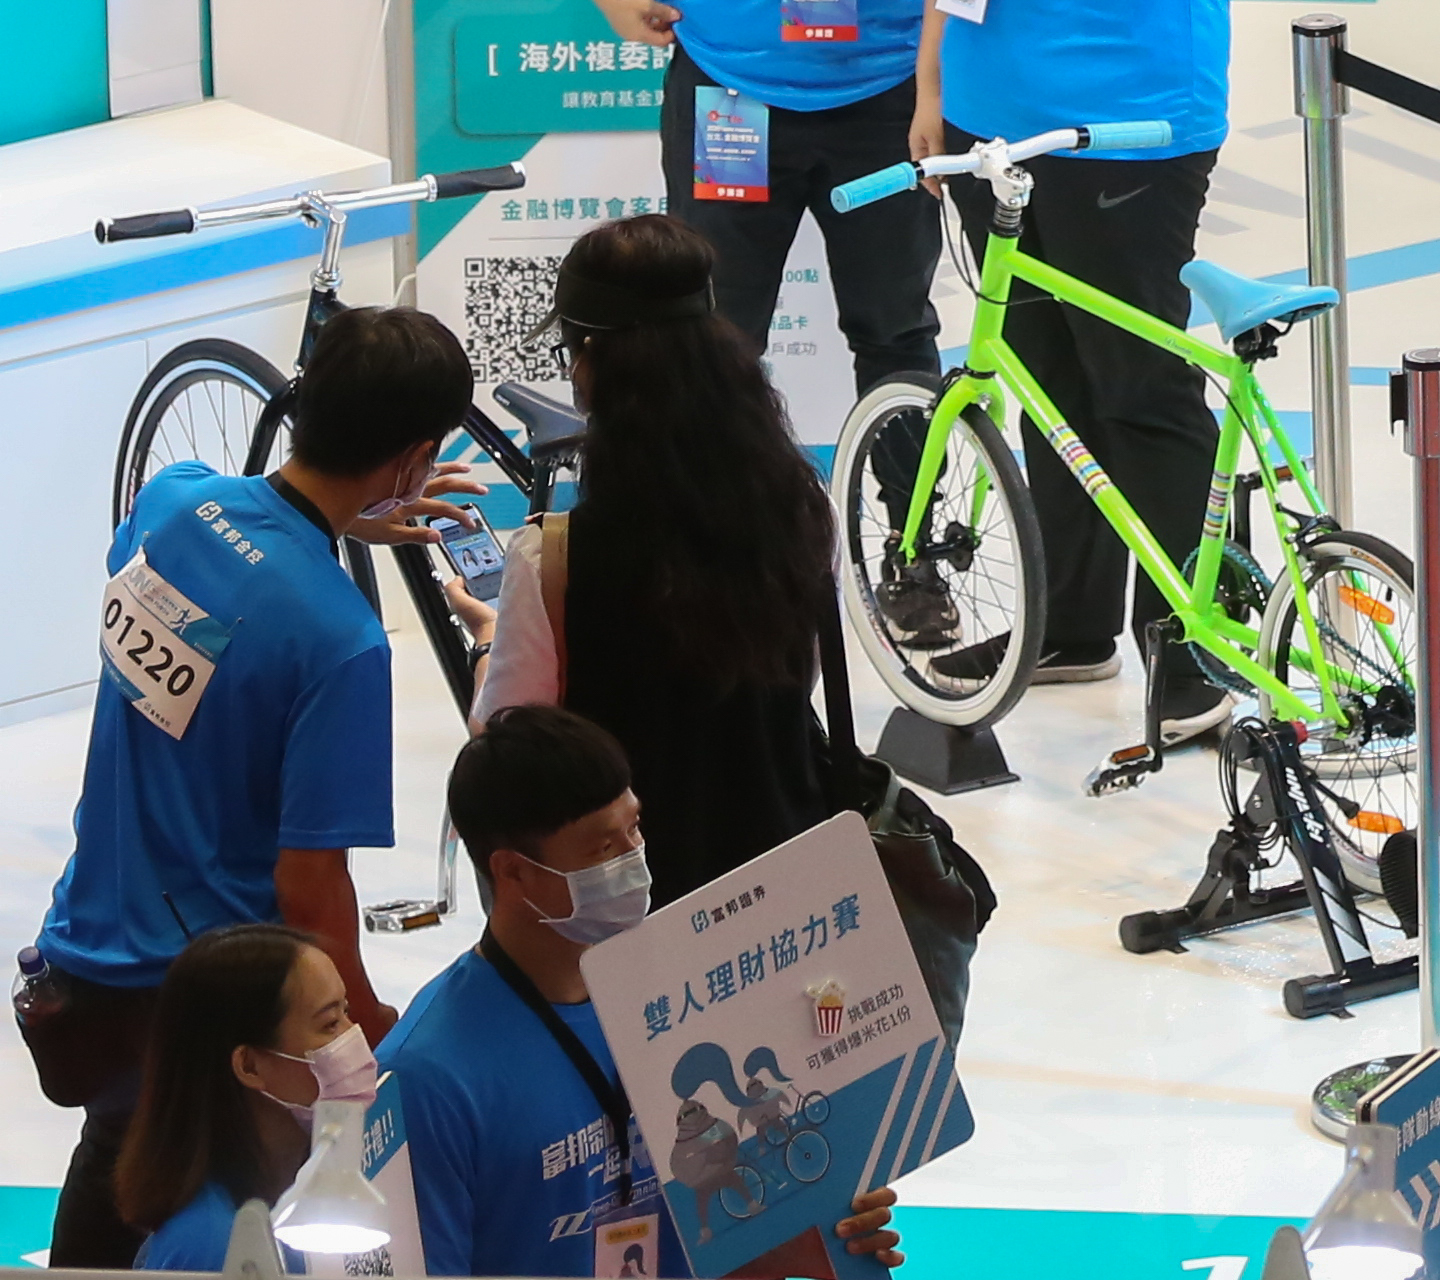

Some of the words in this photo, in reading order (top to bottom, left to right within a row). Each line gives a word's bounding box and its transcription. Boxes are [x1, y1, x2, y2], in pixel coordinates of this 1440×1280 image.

[104, 597, 196, 698] 01220
[710, 885, 768, 925] 富邦證券
[642, 892, 861, 1042] 雙人理財協力賽
[847, 983, 905, 1025] 挑戰成功
